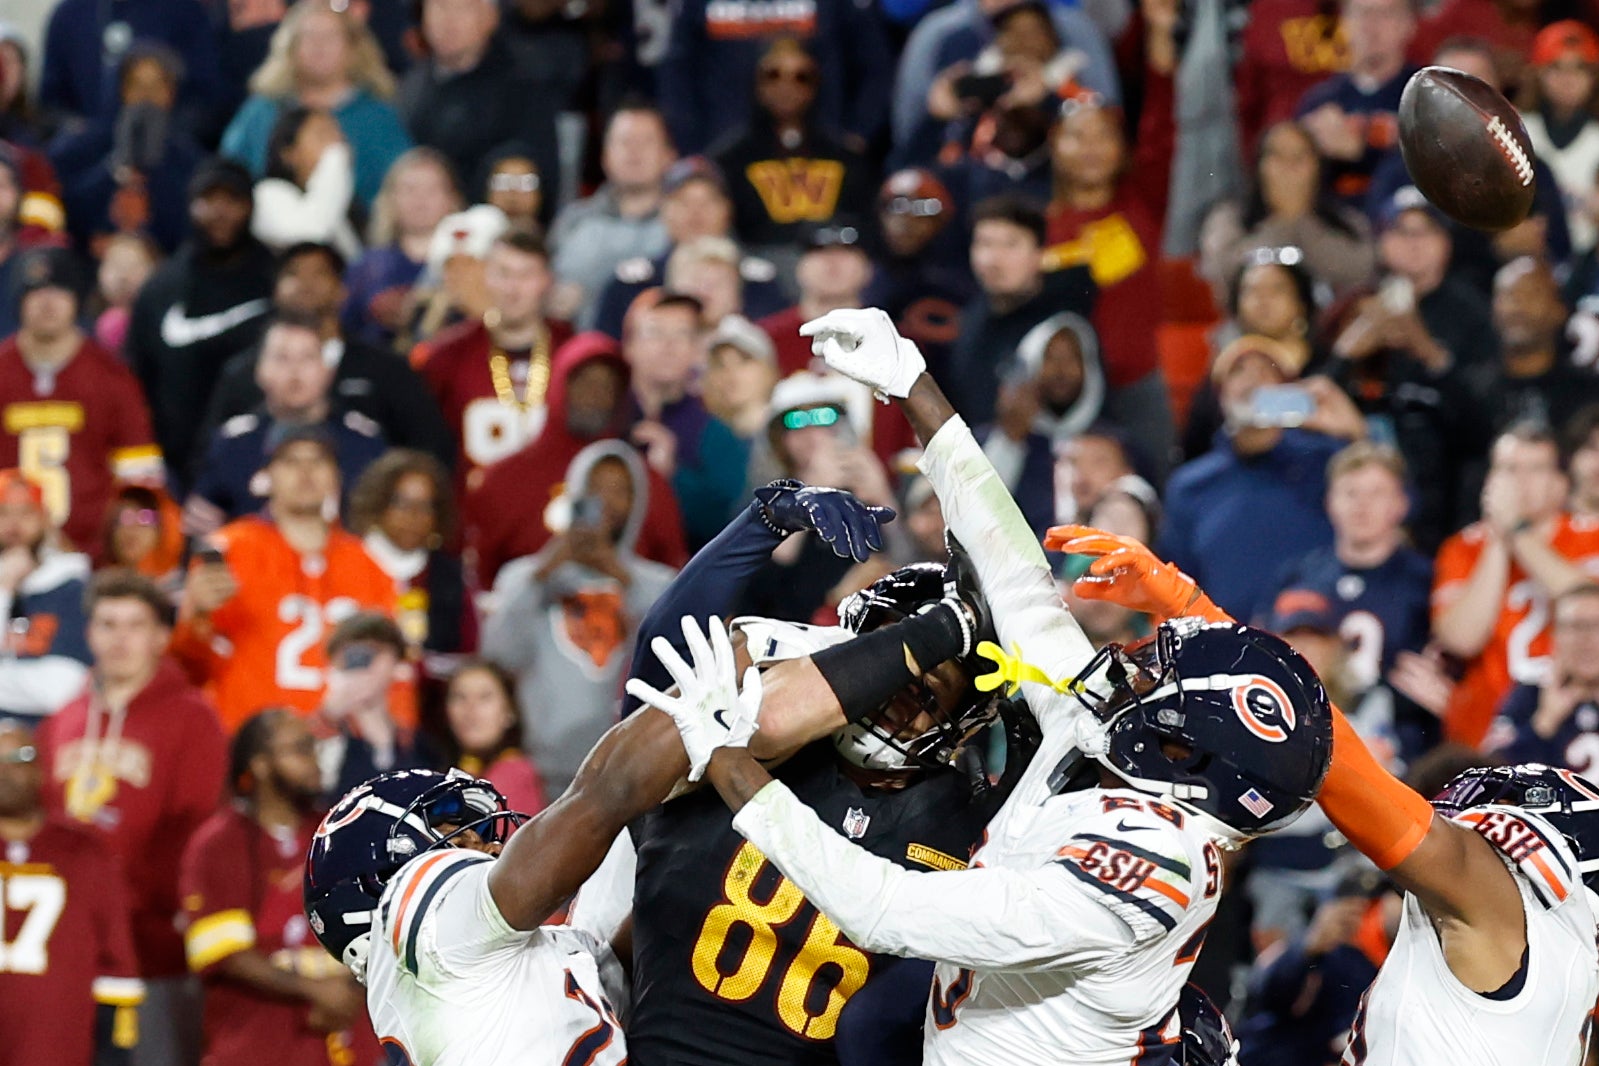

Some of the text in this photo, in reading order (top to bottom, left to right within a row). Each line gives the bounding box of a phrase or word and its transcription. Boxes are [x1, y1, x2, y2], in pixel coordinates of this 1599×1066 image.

[1473, 811, 1546, 866] GSH
[1079, 841, 1159, 893] GSH
[691, 838, 870, 1040] 86
